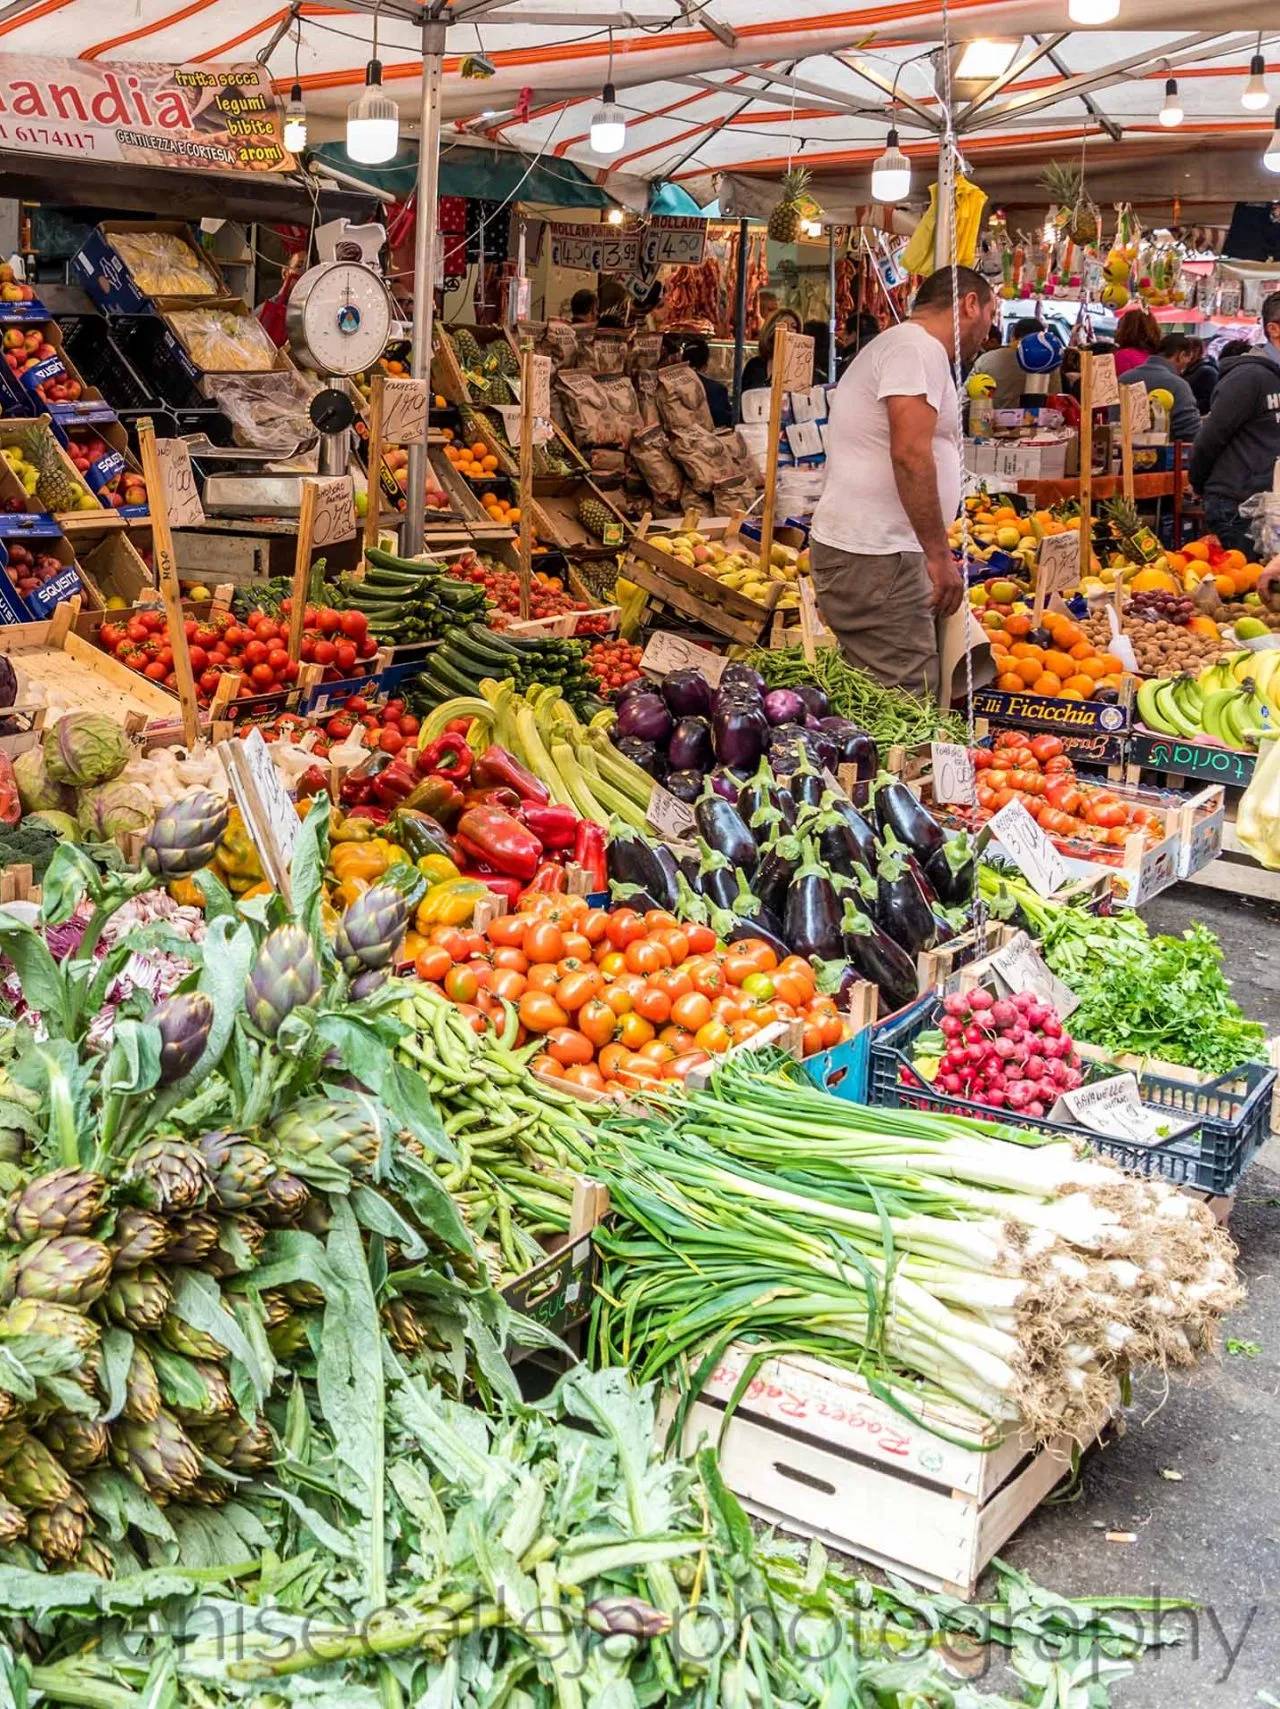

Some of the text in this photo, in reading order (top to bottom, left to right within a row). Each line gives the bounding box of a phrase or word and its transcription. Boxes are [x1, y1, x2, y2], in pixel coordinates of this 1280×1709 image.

[174, 70, 260, 87] frutta secca
[215, 94, 267, 114] legumi
[227, 118, 274, 136] bibite
[15, 126, 96, 150] 6174117
[116, 129, 177, 153] GENTILEZZA
[186, 142, 237, 164] CORTESIA
[239, 143, 284, 161] aromi
[551, 223, 591, 238] MOLLAM
[1006, 697, 1096, 725] Ficicchia
[817, 1405, 913, 1457] Roger
